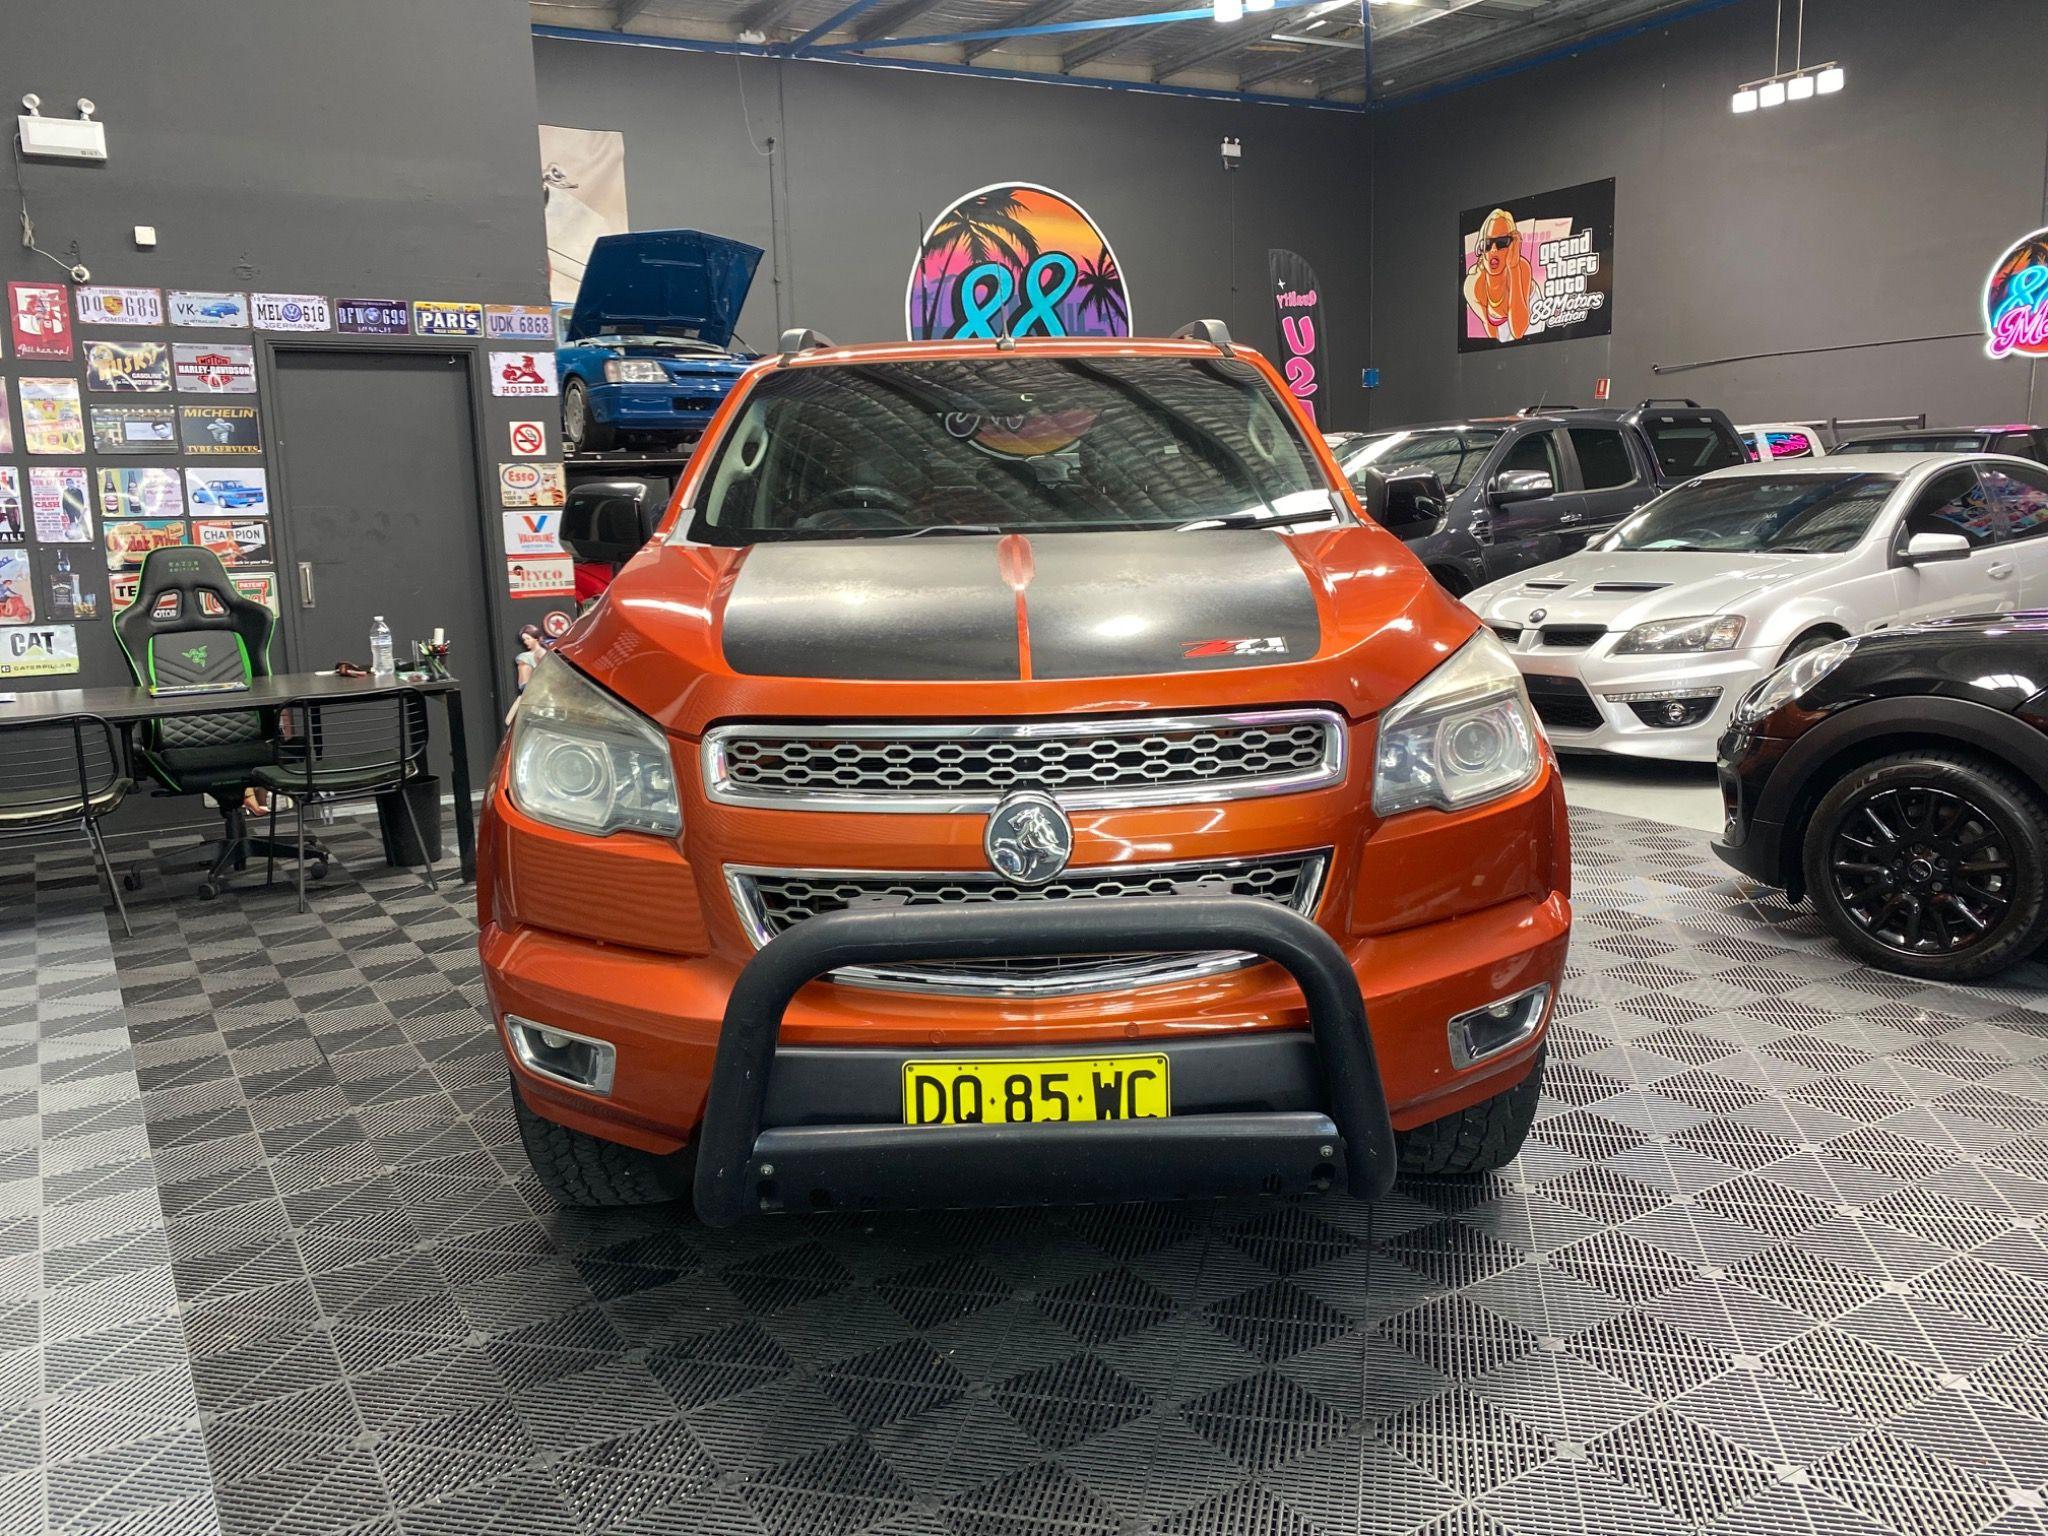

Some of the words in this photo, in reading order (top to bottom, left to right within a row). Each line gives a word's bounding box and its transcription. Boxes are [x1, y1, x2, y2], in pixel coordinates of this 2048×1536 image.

[1540, 228, 1592, 264] grand
[1547, 254, 1599, 280] theft
[1545, 275, 1586, 297] auto
[125, 296, 159, 318] 689
[257, 304, 284, 321] MEL
[302, 306, 325, 323] 618
[422, 312, 477, 329] PARIS
[489, 314, 514, 333] UDK
[519, 316, 549, 334] 6868
[1548, 309, 1588, 327] edition
[178, 364, 250, 376] HARLEY-DAVIDSON
[501, 385, 549, 394] HOLDEN
[184, 408, 254, 418] MICHELIN
[187, 444, 214, 454] TYRE
[215, 444, 258, 454] SERVICES
[508, 470, 535, 482] Esso
[113, 534, 151, 552] Kdak
[518, 532, 555, 544] VALVOLINE
[520, 569, 563, 582] RYCO
[115, 585, 138, 597] TE
[520, 580, 566, 589] FILTERS
[10, 631, 55, 657] CAT
